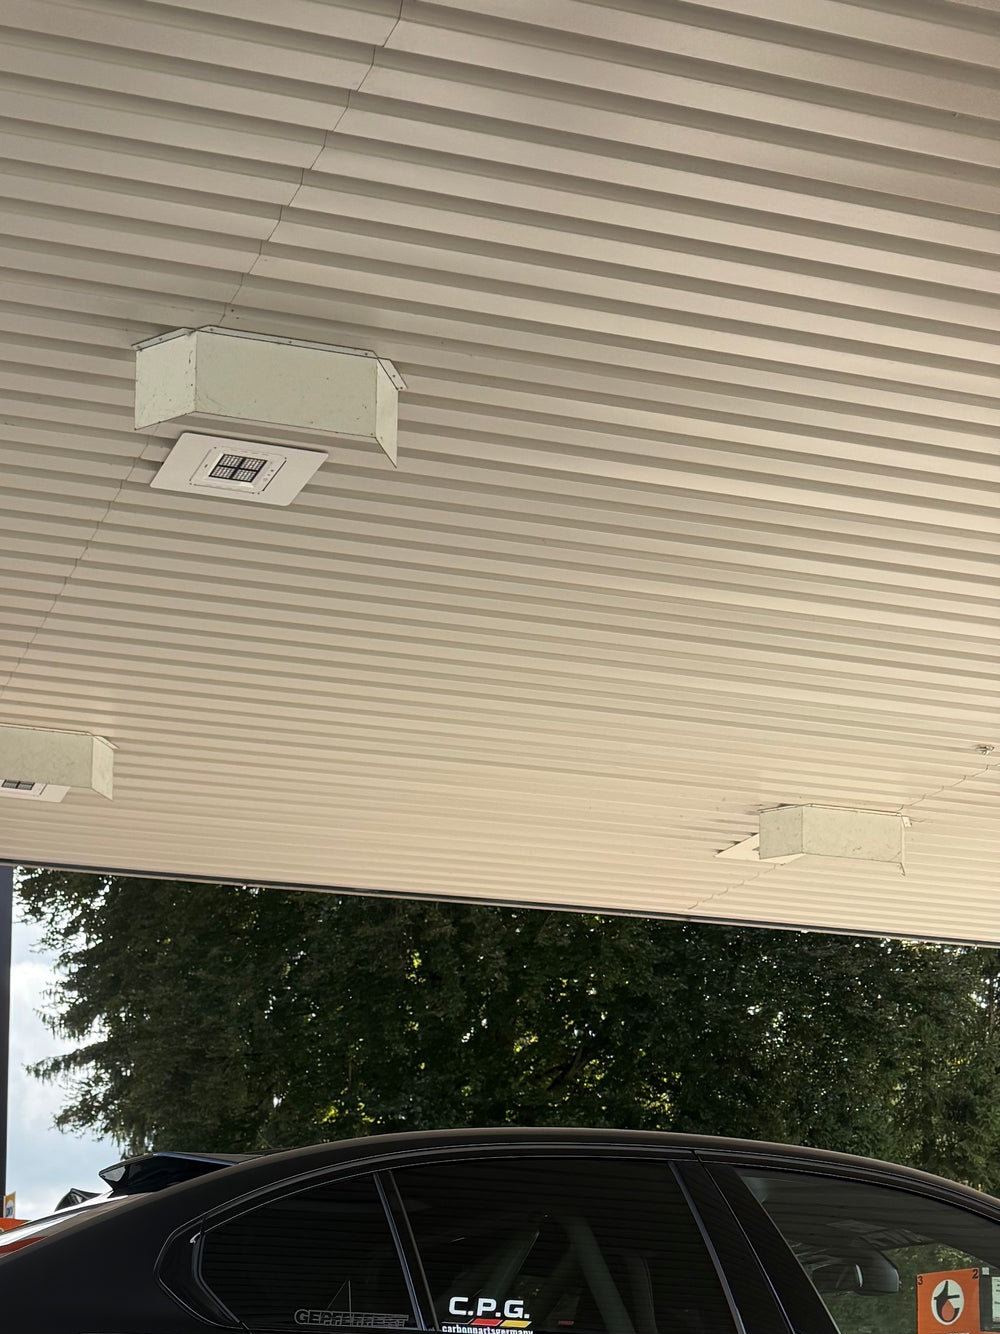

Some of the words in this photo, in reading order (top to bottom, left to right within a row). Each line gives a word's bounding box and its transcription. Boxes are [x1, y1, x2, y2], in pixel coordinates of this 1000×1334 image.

[972, 1269, 979, 1279] 2
[917, 1276, 923, 1285] 3
[449, 1296, 530, 1319] C.P.G.
